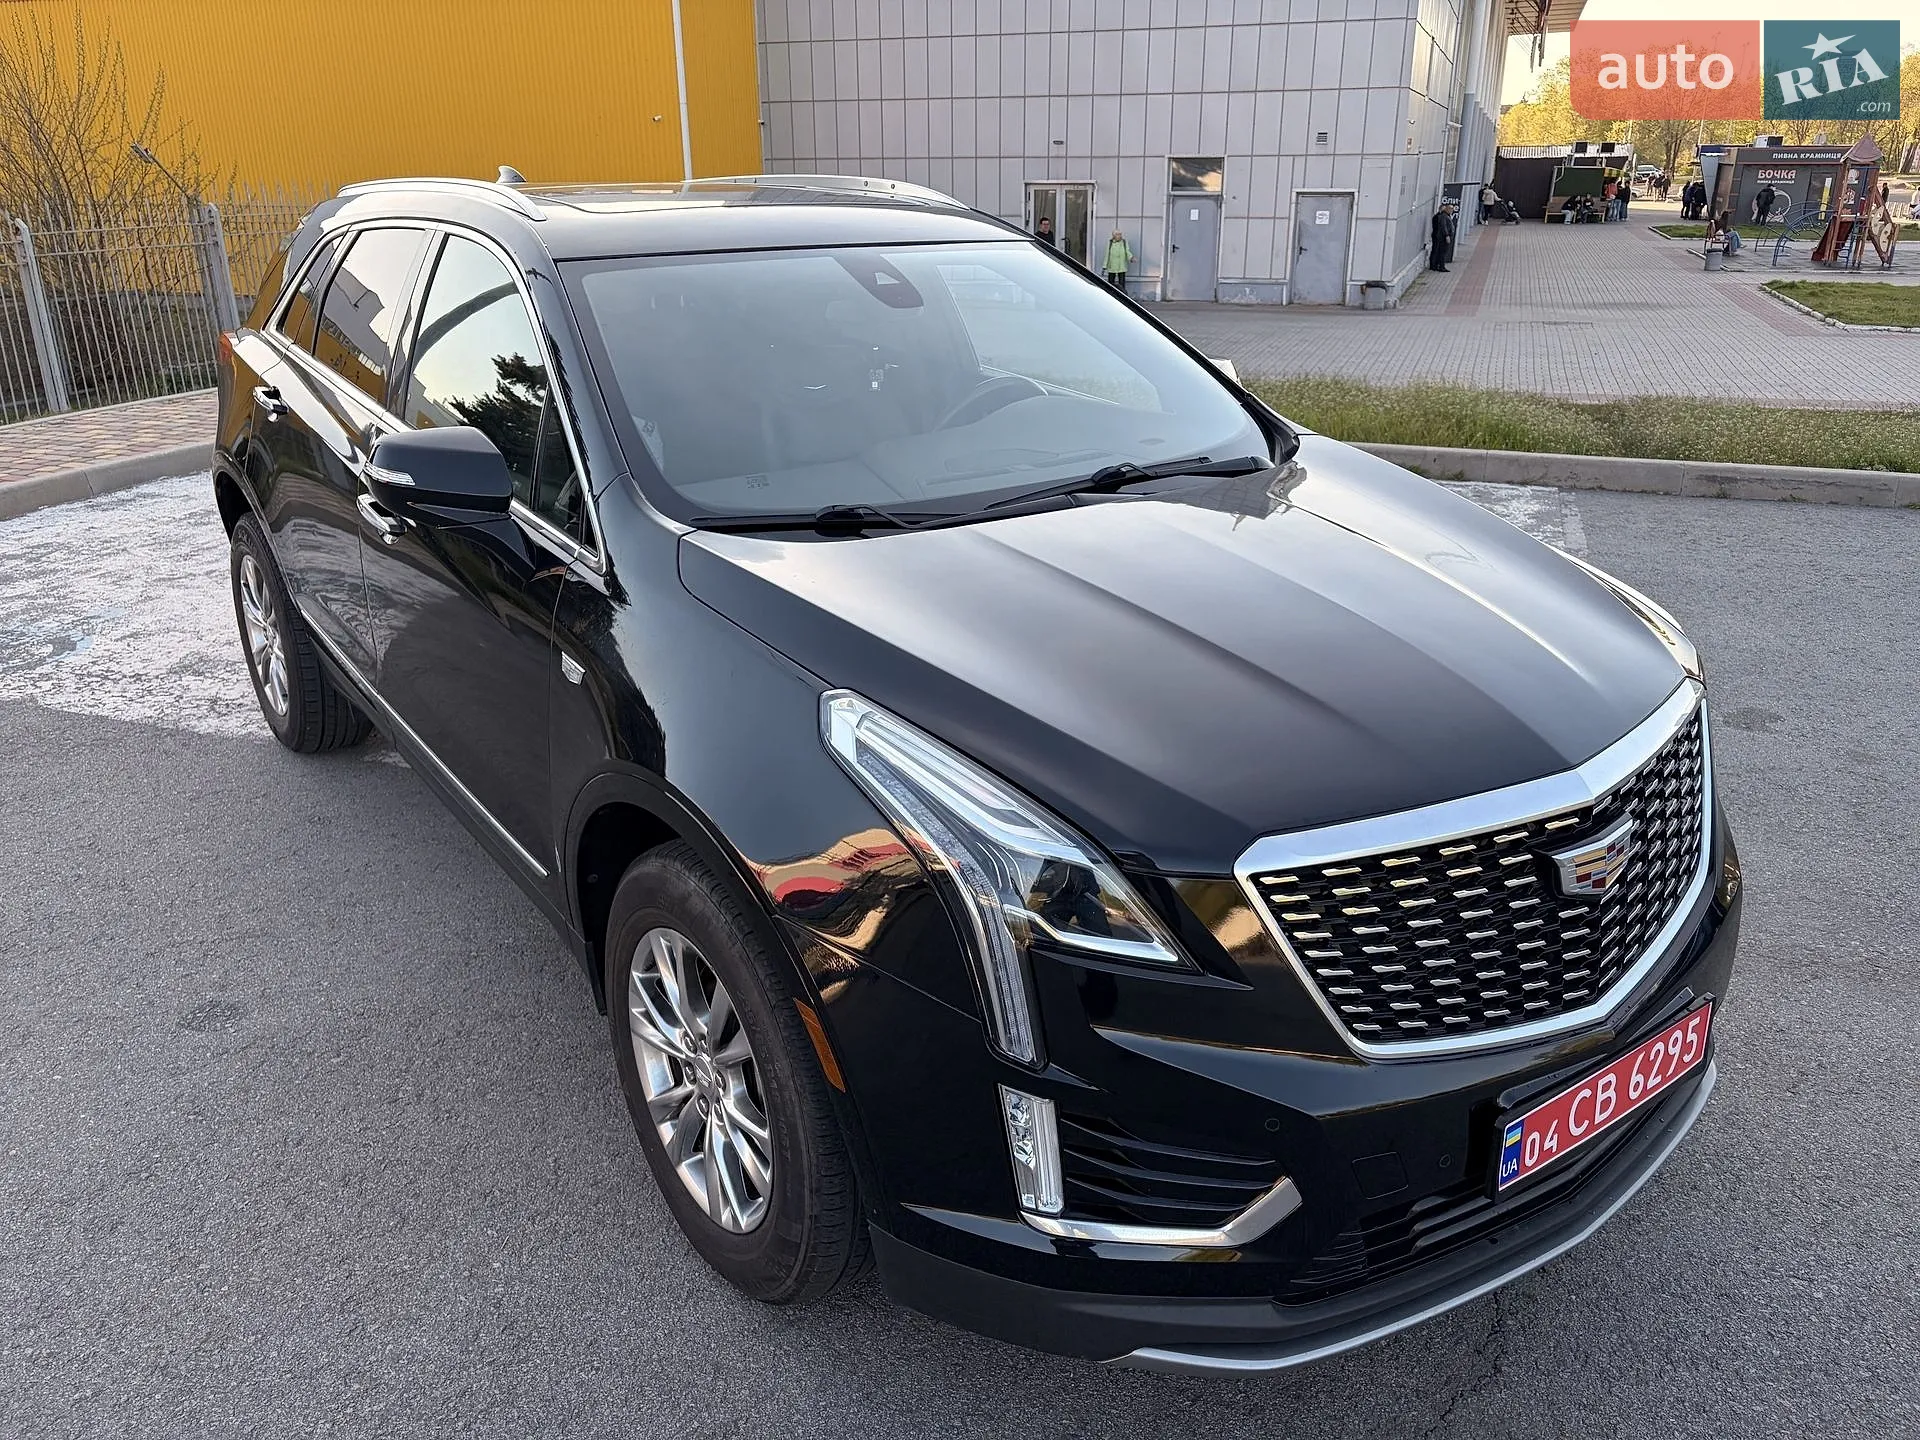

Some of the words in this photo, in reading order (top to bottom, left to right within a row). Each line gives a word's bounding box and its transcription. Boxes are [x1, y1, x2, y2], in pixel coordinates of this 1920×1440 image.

[1757, 169, 1797, 179] БОЧКА
[1524, 1119, 1559, 1167] 04
[1628, 1015, 1701, 1100] 6295
[1502, 1161, 1518, 1178] UA
